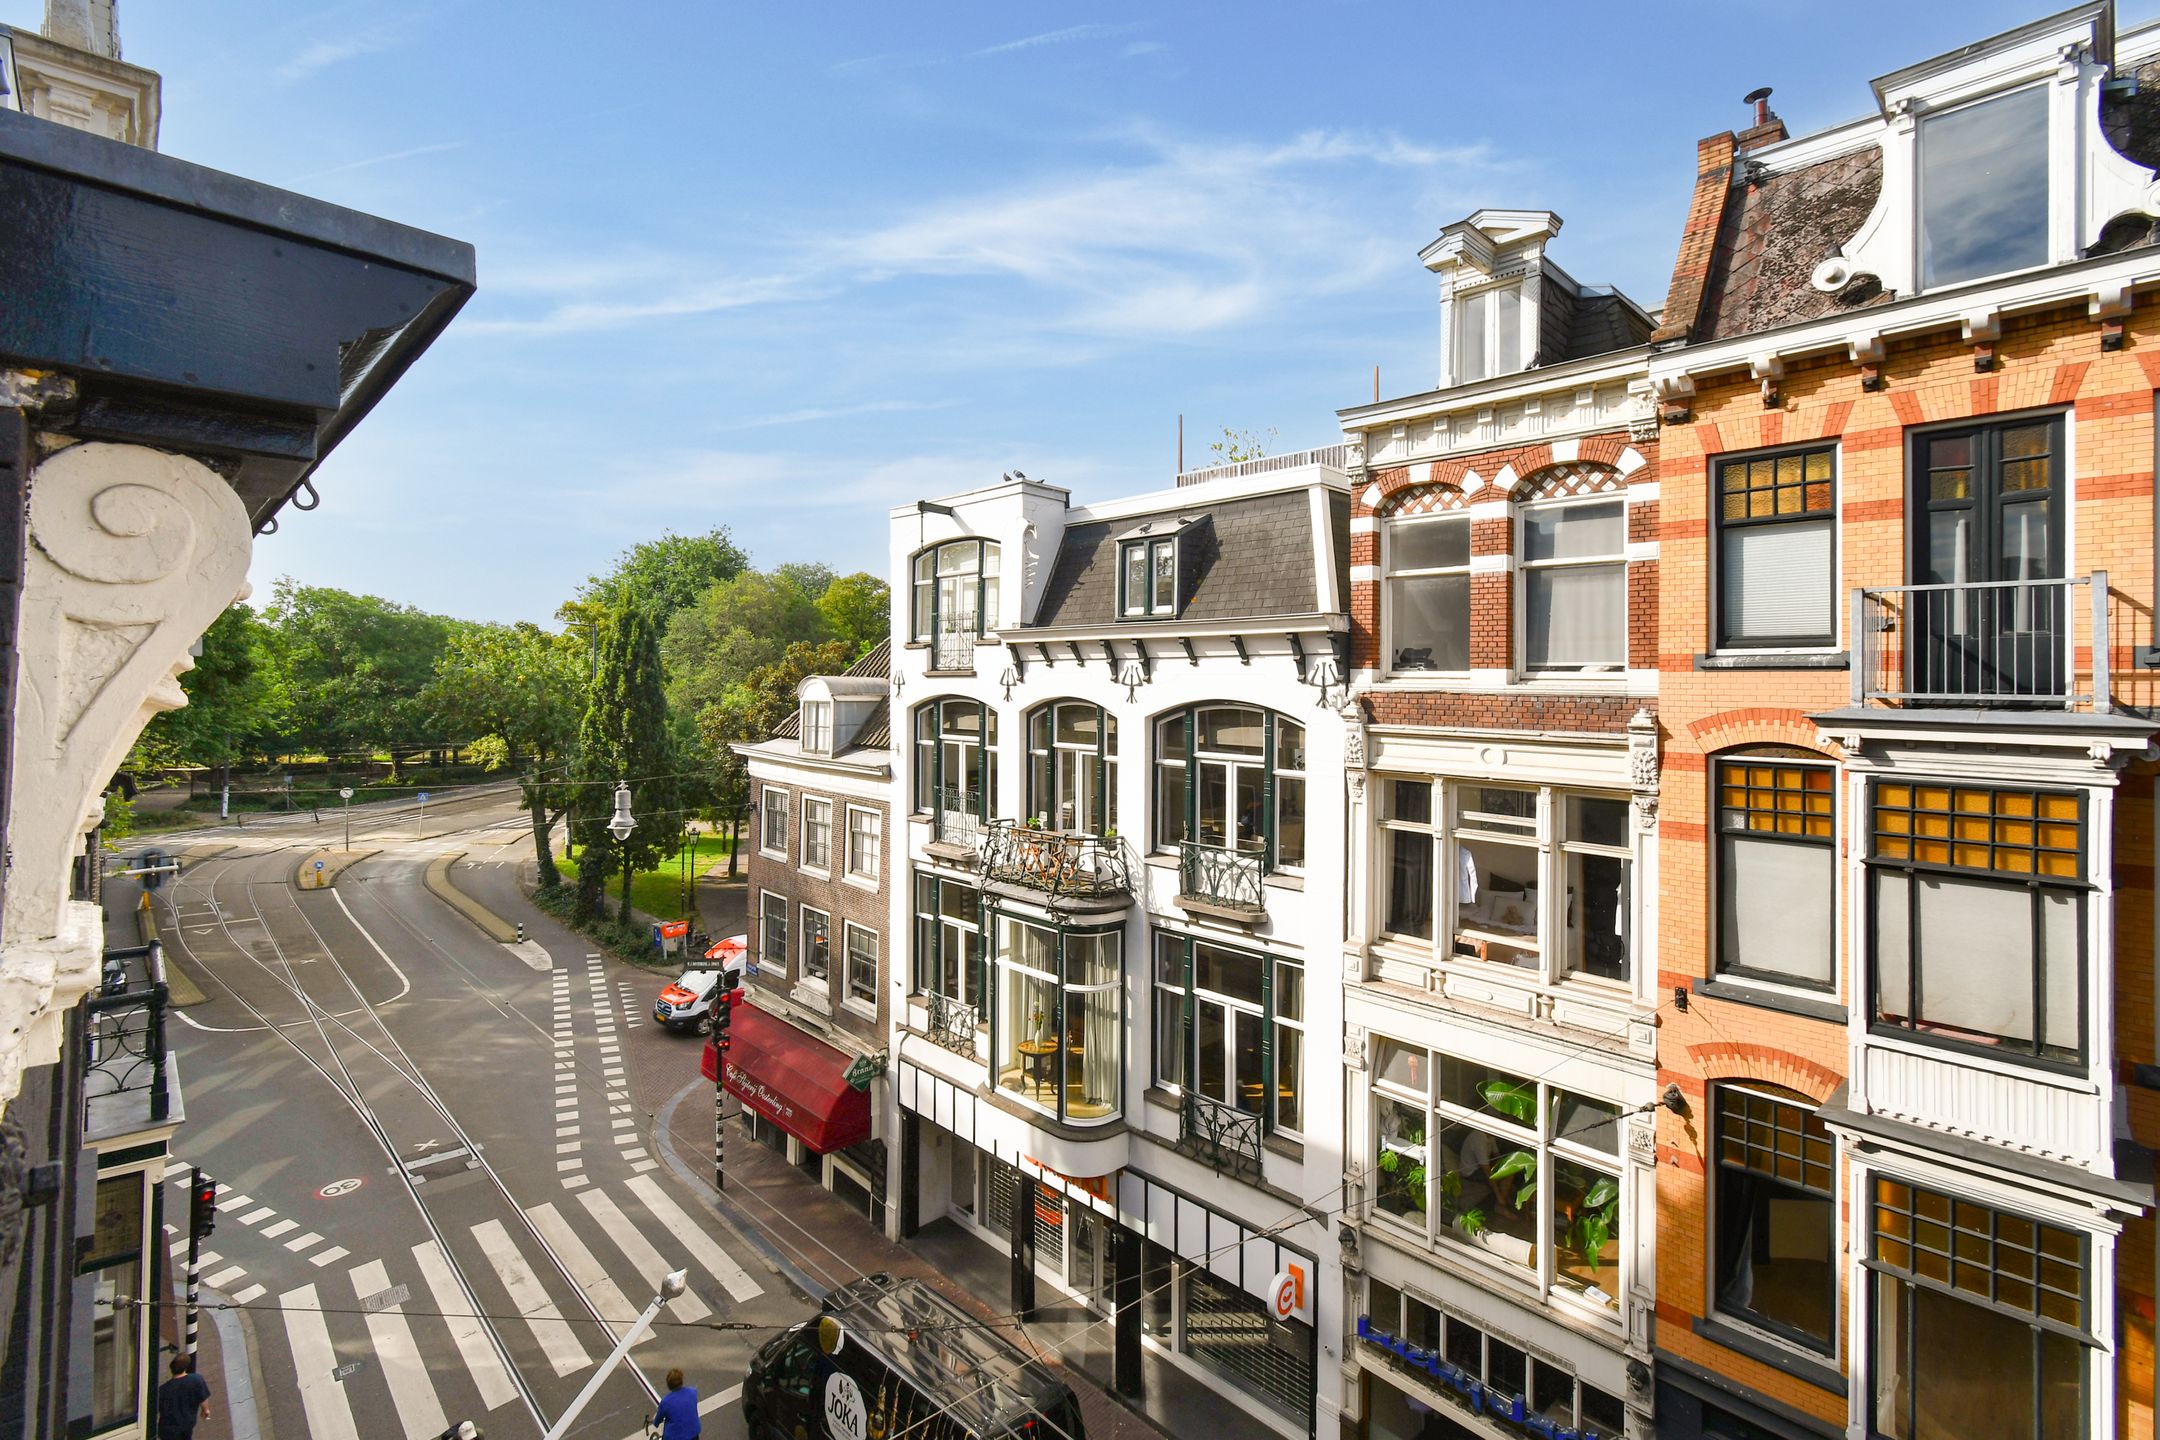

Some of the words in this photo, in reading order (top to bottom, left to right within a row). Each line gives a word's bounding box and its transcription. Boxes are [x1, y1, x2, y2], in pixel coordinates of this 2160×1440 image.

[852, 1063, 874, 1077] Brand
[322, 1180, 359, 1196] 30
[827, 1391, 859, 1438] JOKA
